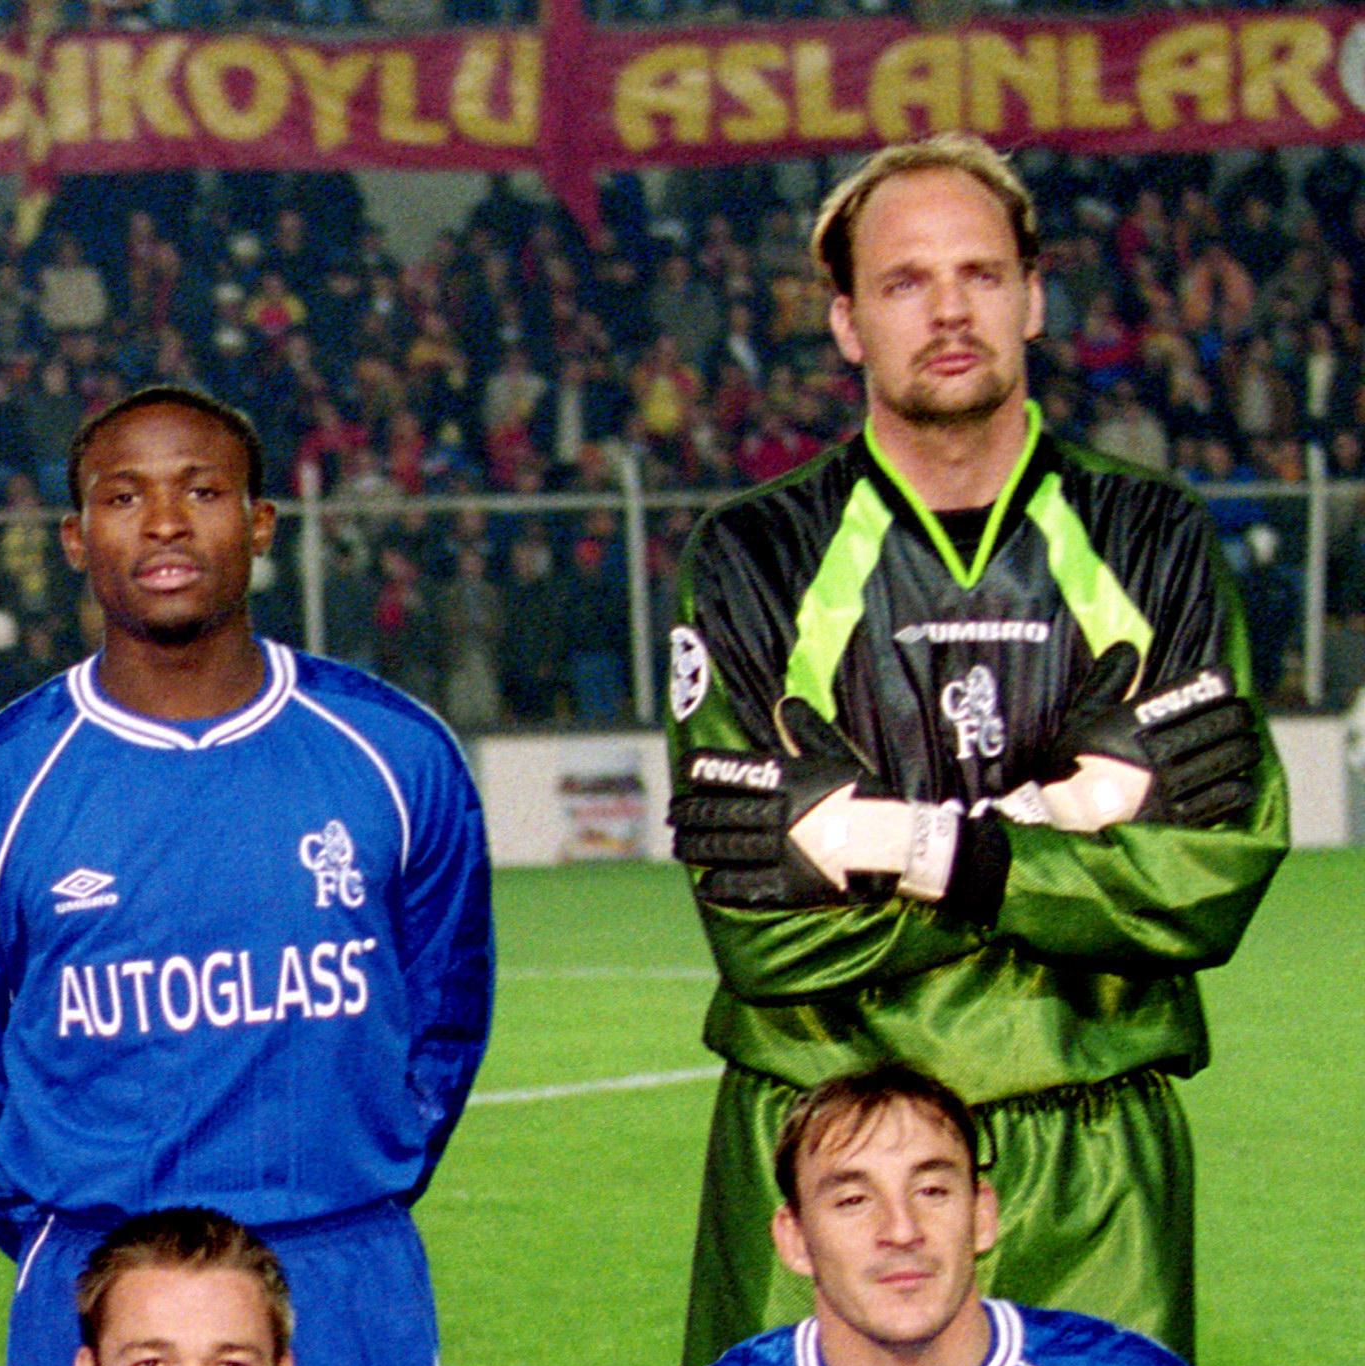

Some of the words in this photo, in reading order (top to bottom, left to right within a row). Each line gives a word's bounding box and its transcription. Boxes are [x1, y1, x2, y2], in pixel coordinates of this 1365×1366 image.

[611, 16, 1343, 152] ASLANLAR
[927, 621, 1048, 643] UMBRO
[1135, 671, 1227, 725] reusch
[690, 758, 781, 789] reusch
[58, 939, 368, 1037] AUTOGLASS
